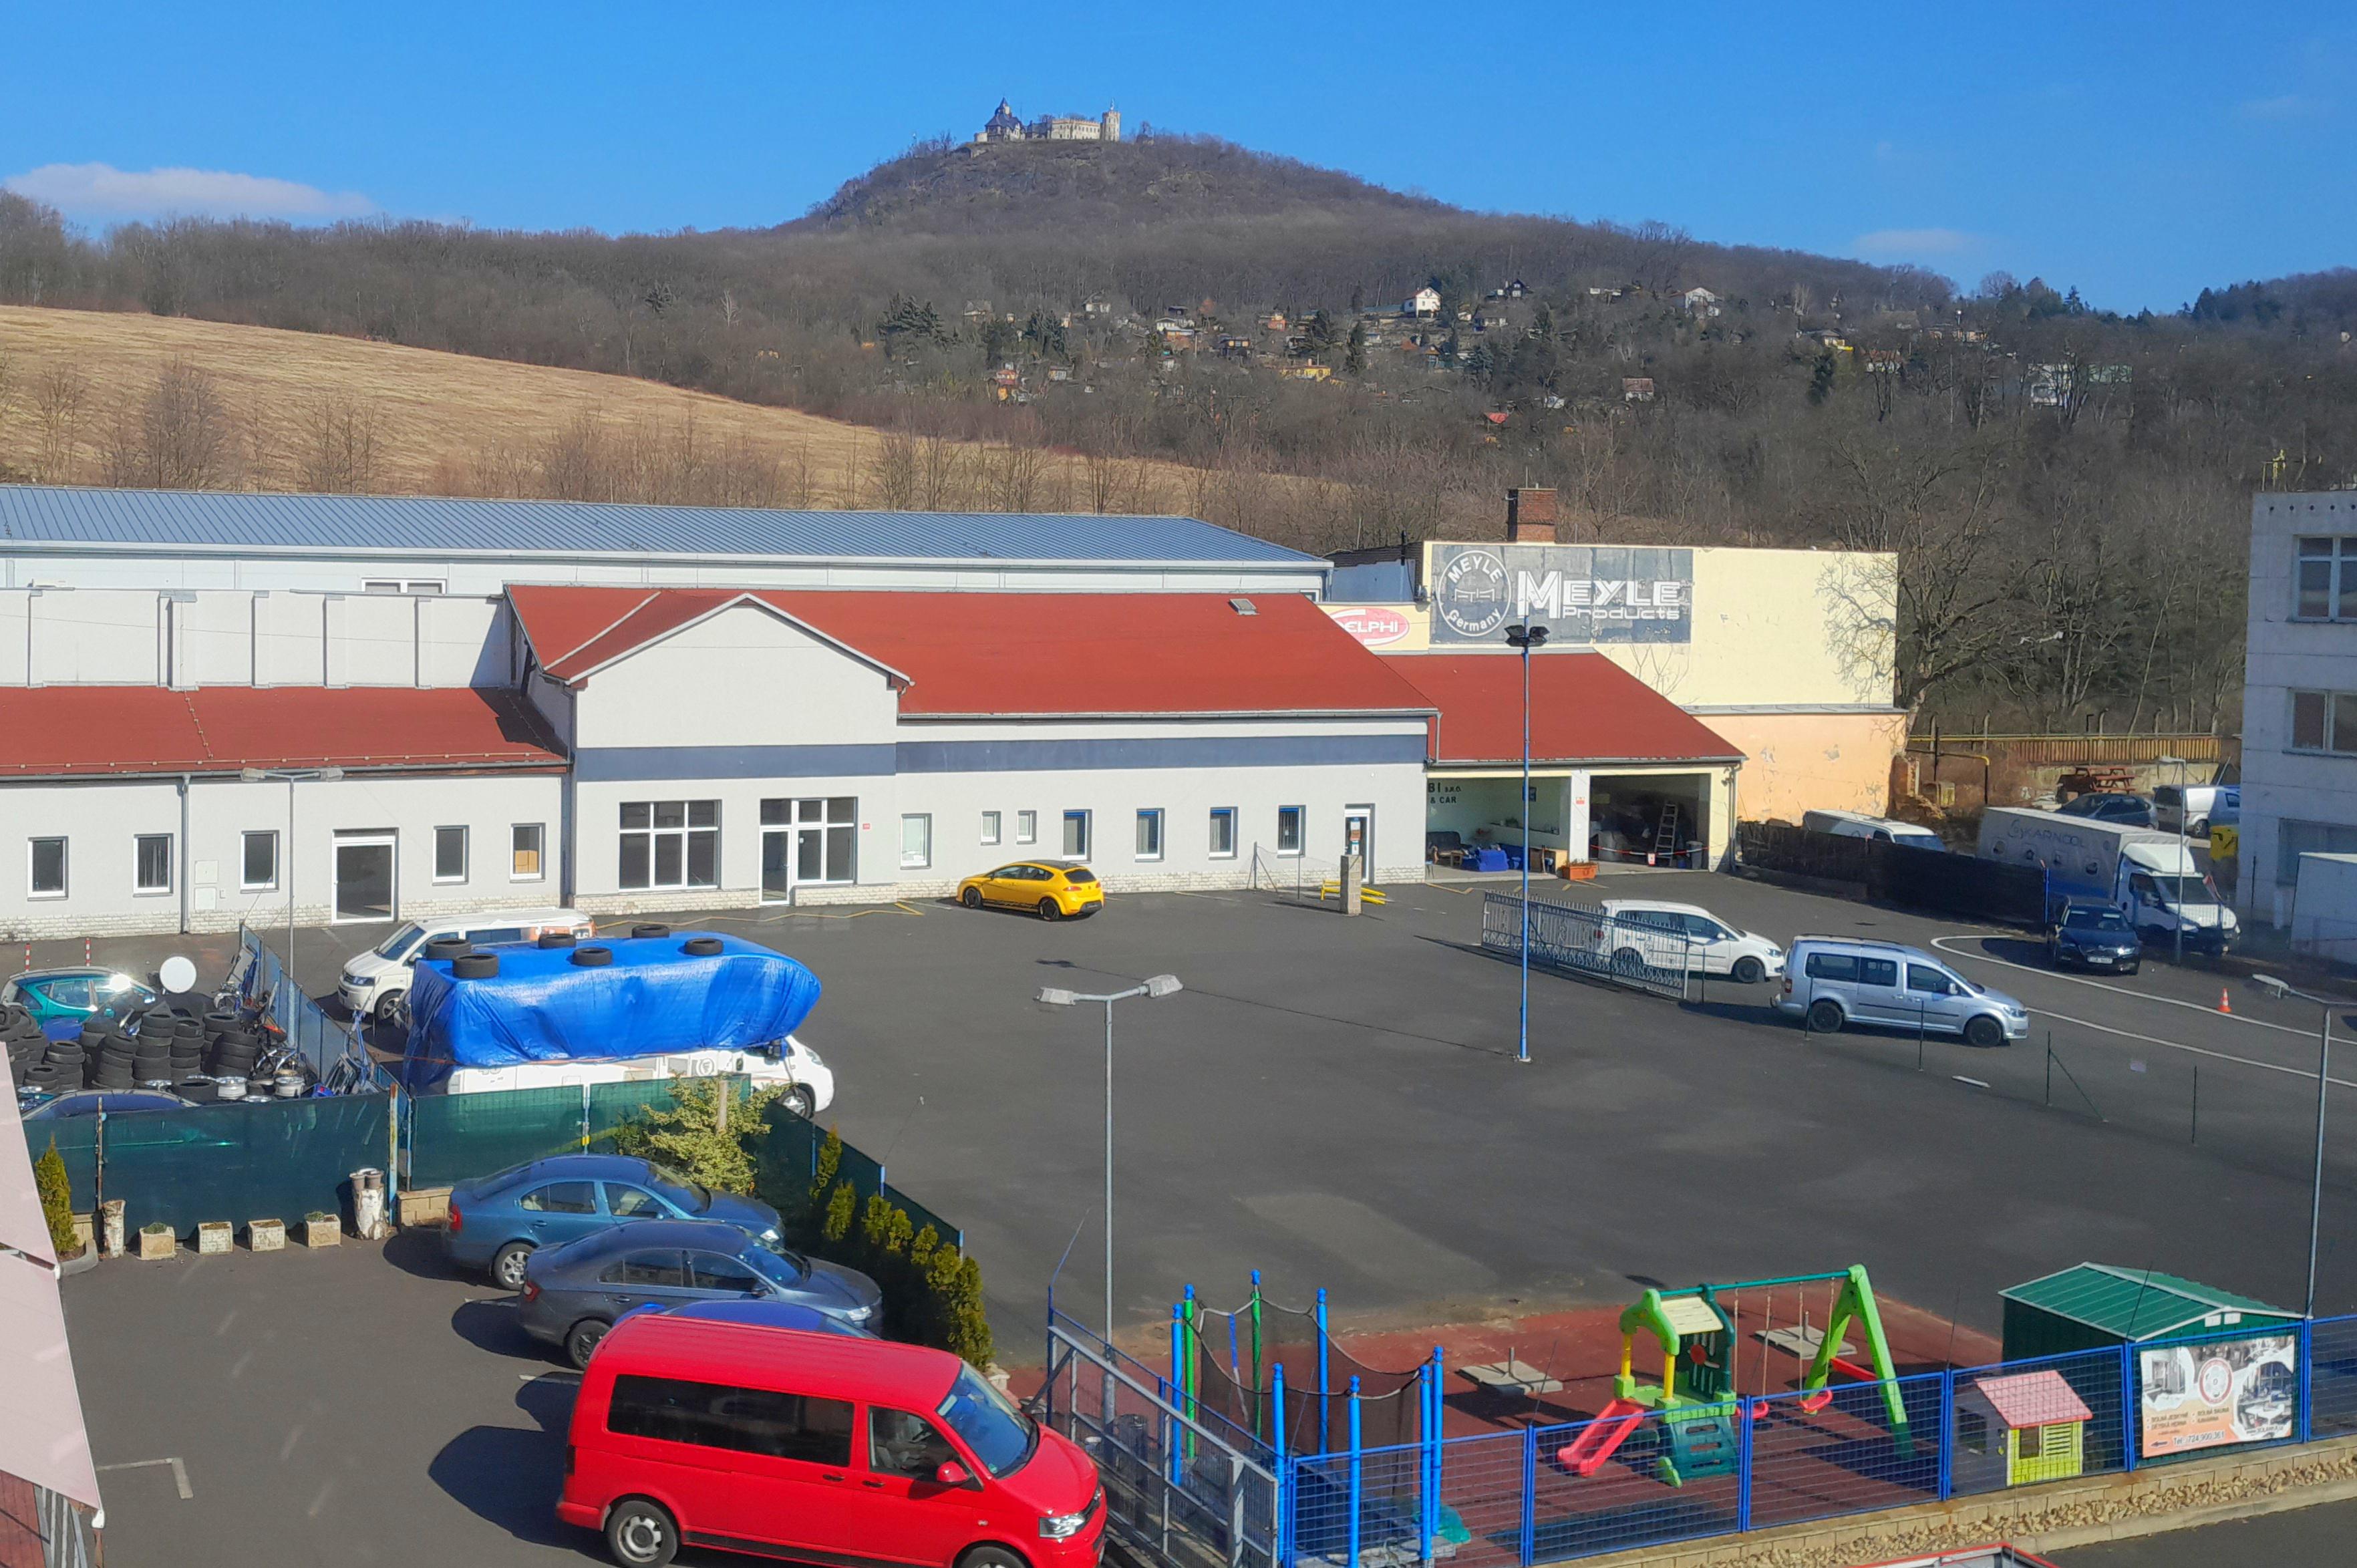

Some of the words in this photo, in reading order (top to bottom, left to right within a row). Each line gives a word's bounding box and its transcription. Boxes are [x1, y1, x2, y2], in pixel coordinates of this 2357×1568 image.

[1448, 555, 1503, 583] MEYLE
[1517, 571, 1680, 619] MEYLE
[1446, 608, 1501, 631] Germany
[1562, 606, 1680, 620] Products
[1439, 796, 1457, 804] CAR
